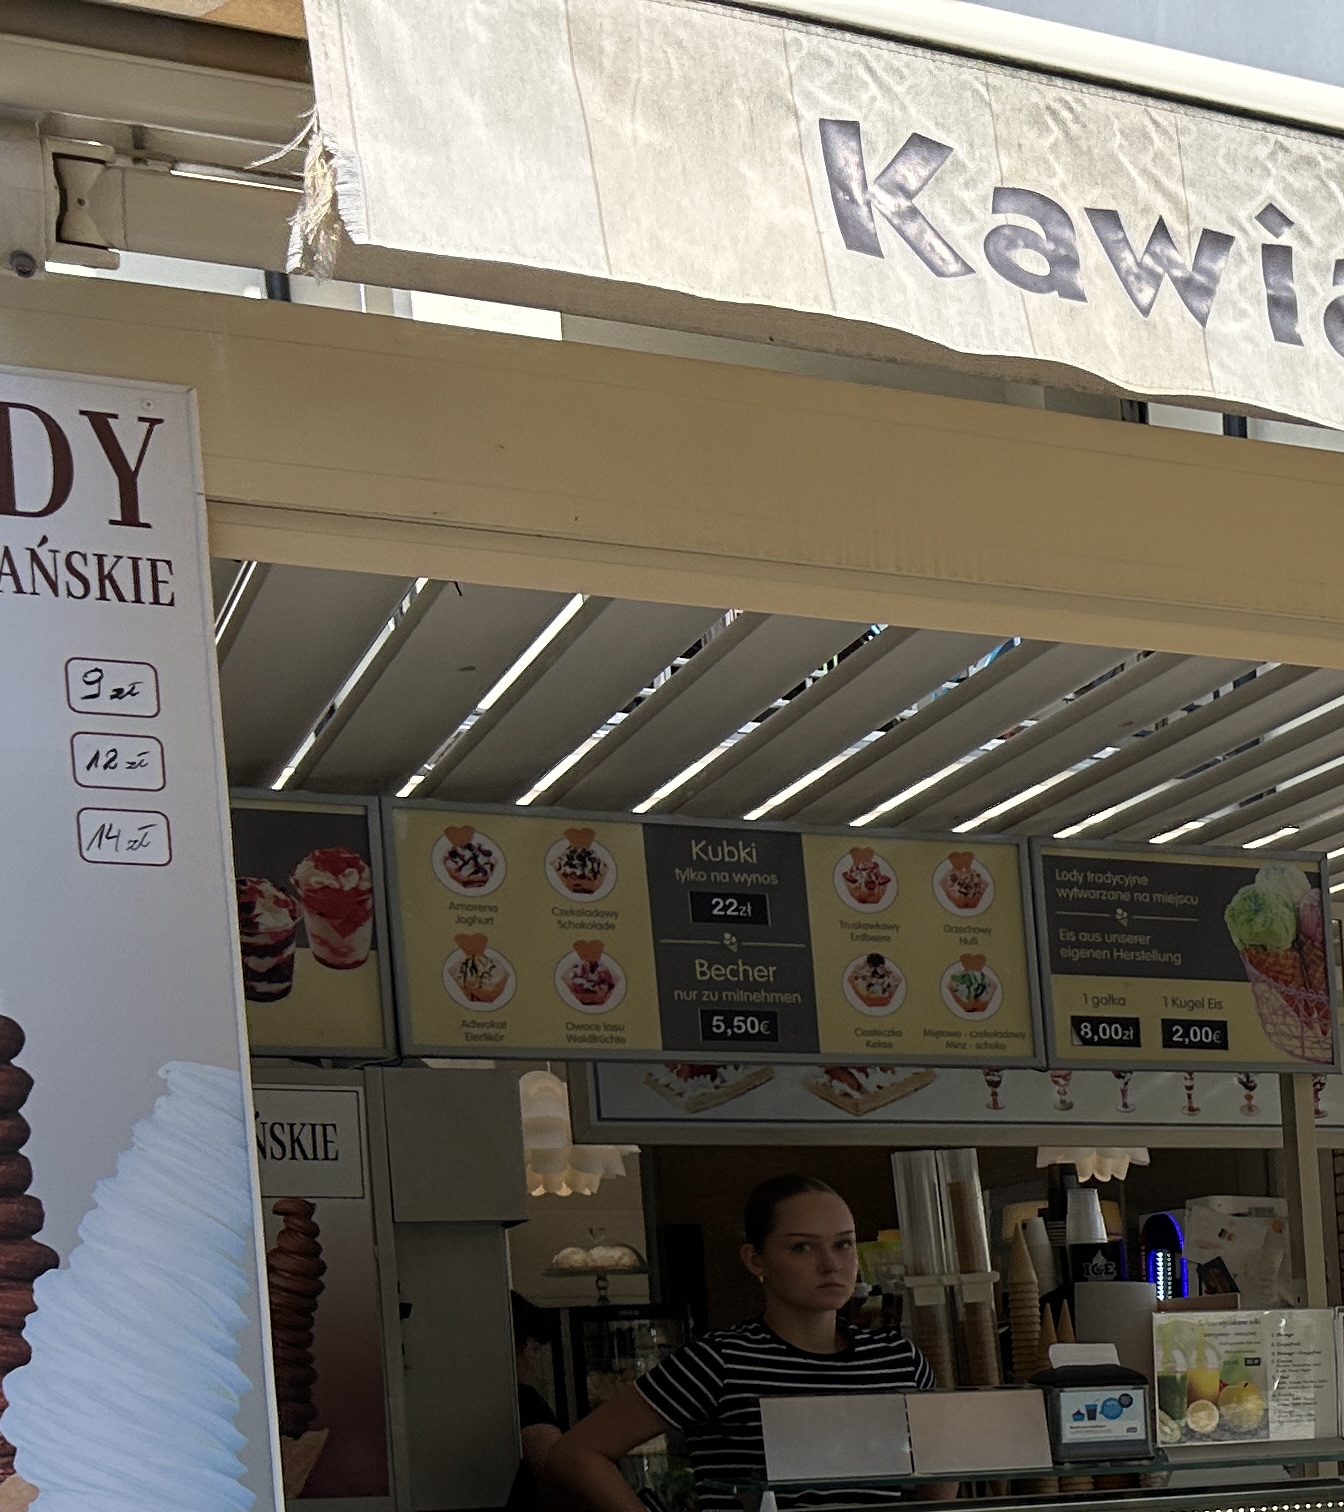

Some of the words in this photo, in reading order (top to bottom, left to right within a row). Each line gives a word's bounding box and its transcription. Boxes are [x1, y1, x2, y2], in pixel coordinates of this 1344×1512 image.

[80, 668, 103, 700] 9
[85, 748, 118, 772] 12
[86, 823, 121, 853] 14
[692, 840, 758, 863] Kubki
[675, 868, 707, 885] tylko
[710, 871, 729, 884] na
[732, 871, 778, 888] wynos
[1055, 869, 1084, 887] Lody
[1087, 870, 1148, 887] tradycyjne
[1056, 887, 1131, 902] wytwarzane
[1134, 889, 1151, 901] na
[1154, 889, 1199, 906] miejscu
[448, 901, 498, 915] Amarena
[551, 907, 620, 922] Czekoladowy
[711, 898, 752, 918] 22zł
[455, 915, 494, 927] Joghurt
[557, 919, 616, 931] Schokolade
[1059, 929, 1075, 942] Eis
[1079, 931, 1101, 943] aus
[1103, 932, 1151, 945] unserer
[1060, 947, 1110, 962] eigenen
[1113, 947, 1182, 965] Herstellung
[695, 959, 778, 983] Becher
[674, 990, 698, 1001] nur
[701, 990, 719, 1002] zu
[722, 987, 801, 1005] mitnehmen
[1091, 993, 1126, 1009] gałka
[1170, 997, 1202, 1011] Kugel
[1205, 998, 1223, 1009] Eis
[711, 1015, 771, 1036] 5,50€
[1080, 1021, 1135, 1043] 8,00zł
[1171, 1025, 1222, 1045] 2,00€
